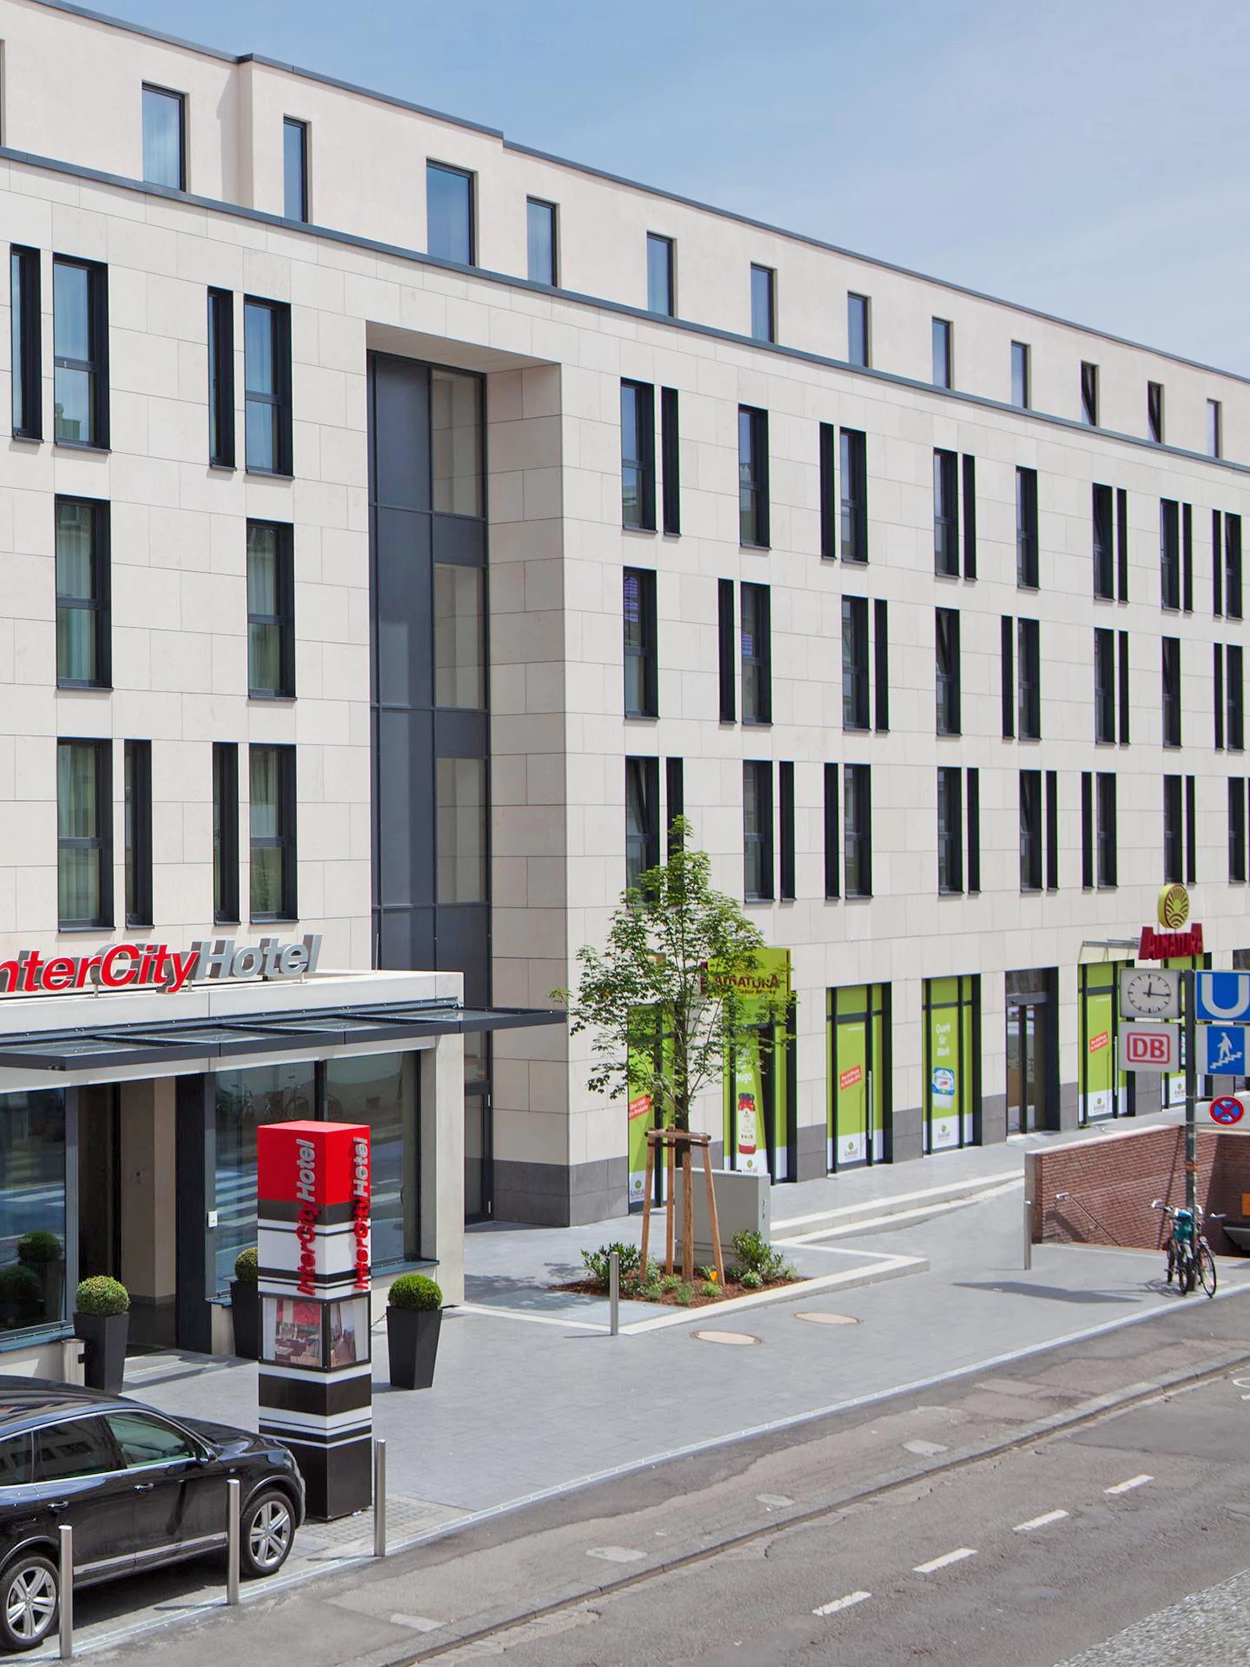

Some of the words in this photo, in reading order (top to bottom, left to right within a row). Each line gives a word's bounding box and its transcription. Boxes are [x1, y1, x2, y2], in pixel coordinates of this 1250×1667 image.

[1201, 973, 1249, 1019] U
[1133, 1037, 1165, 1059] DB
[296, 1138, 319, 1297] InterCityHotel
[352, 1136, 370, 1290] InterCityHotel
